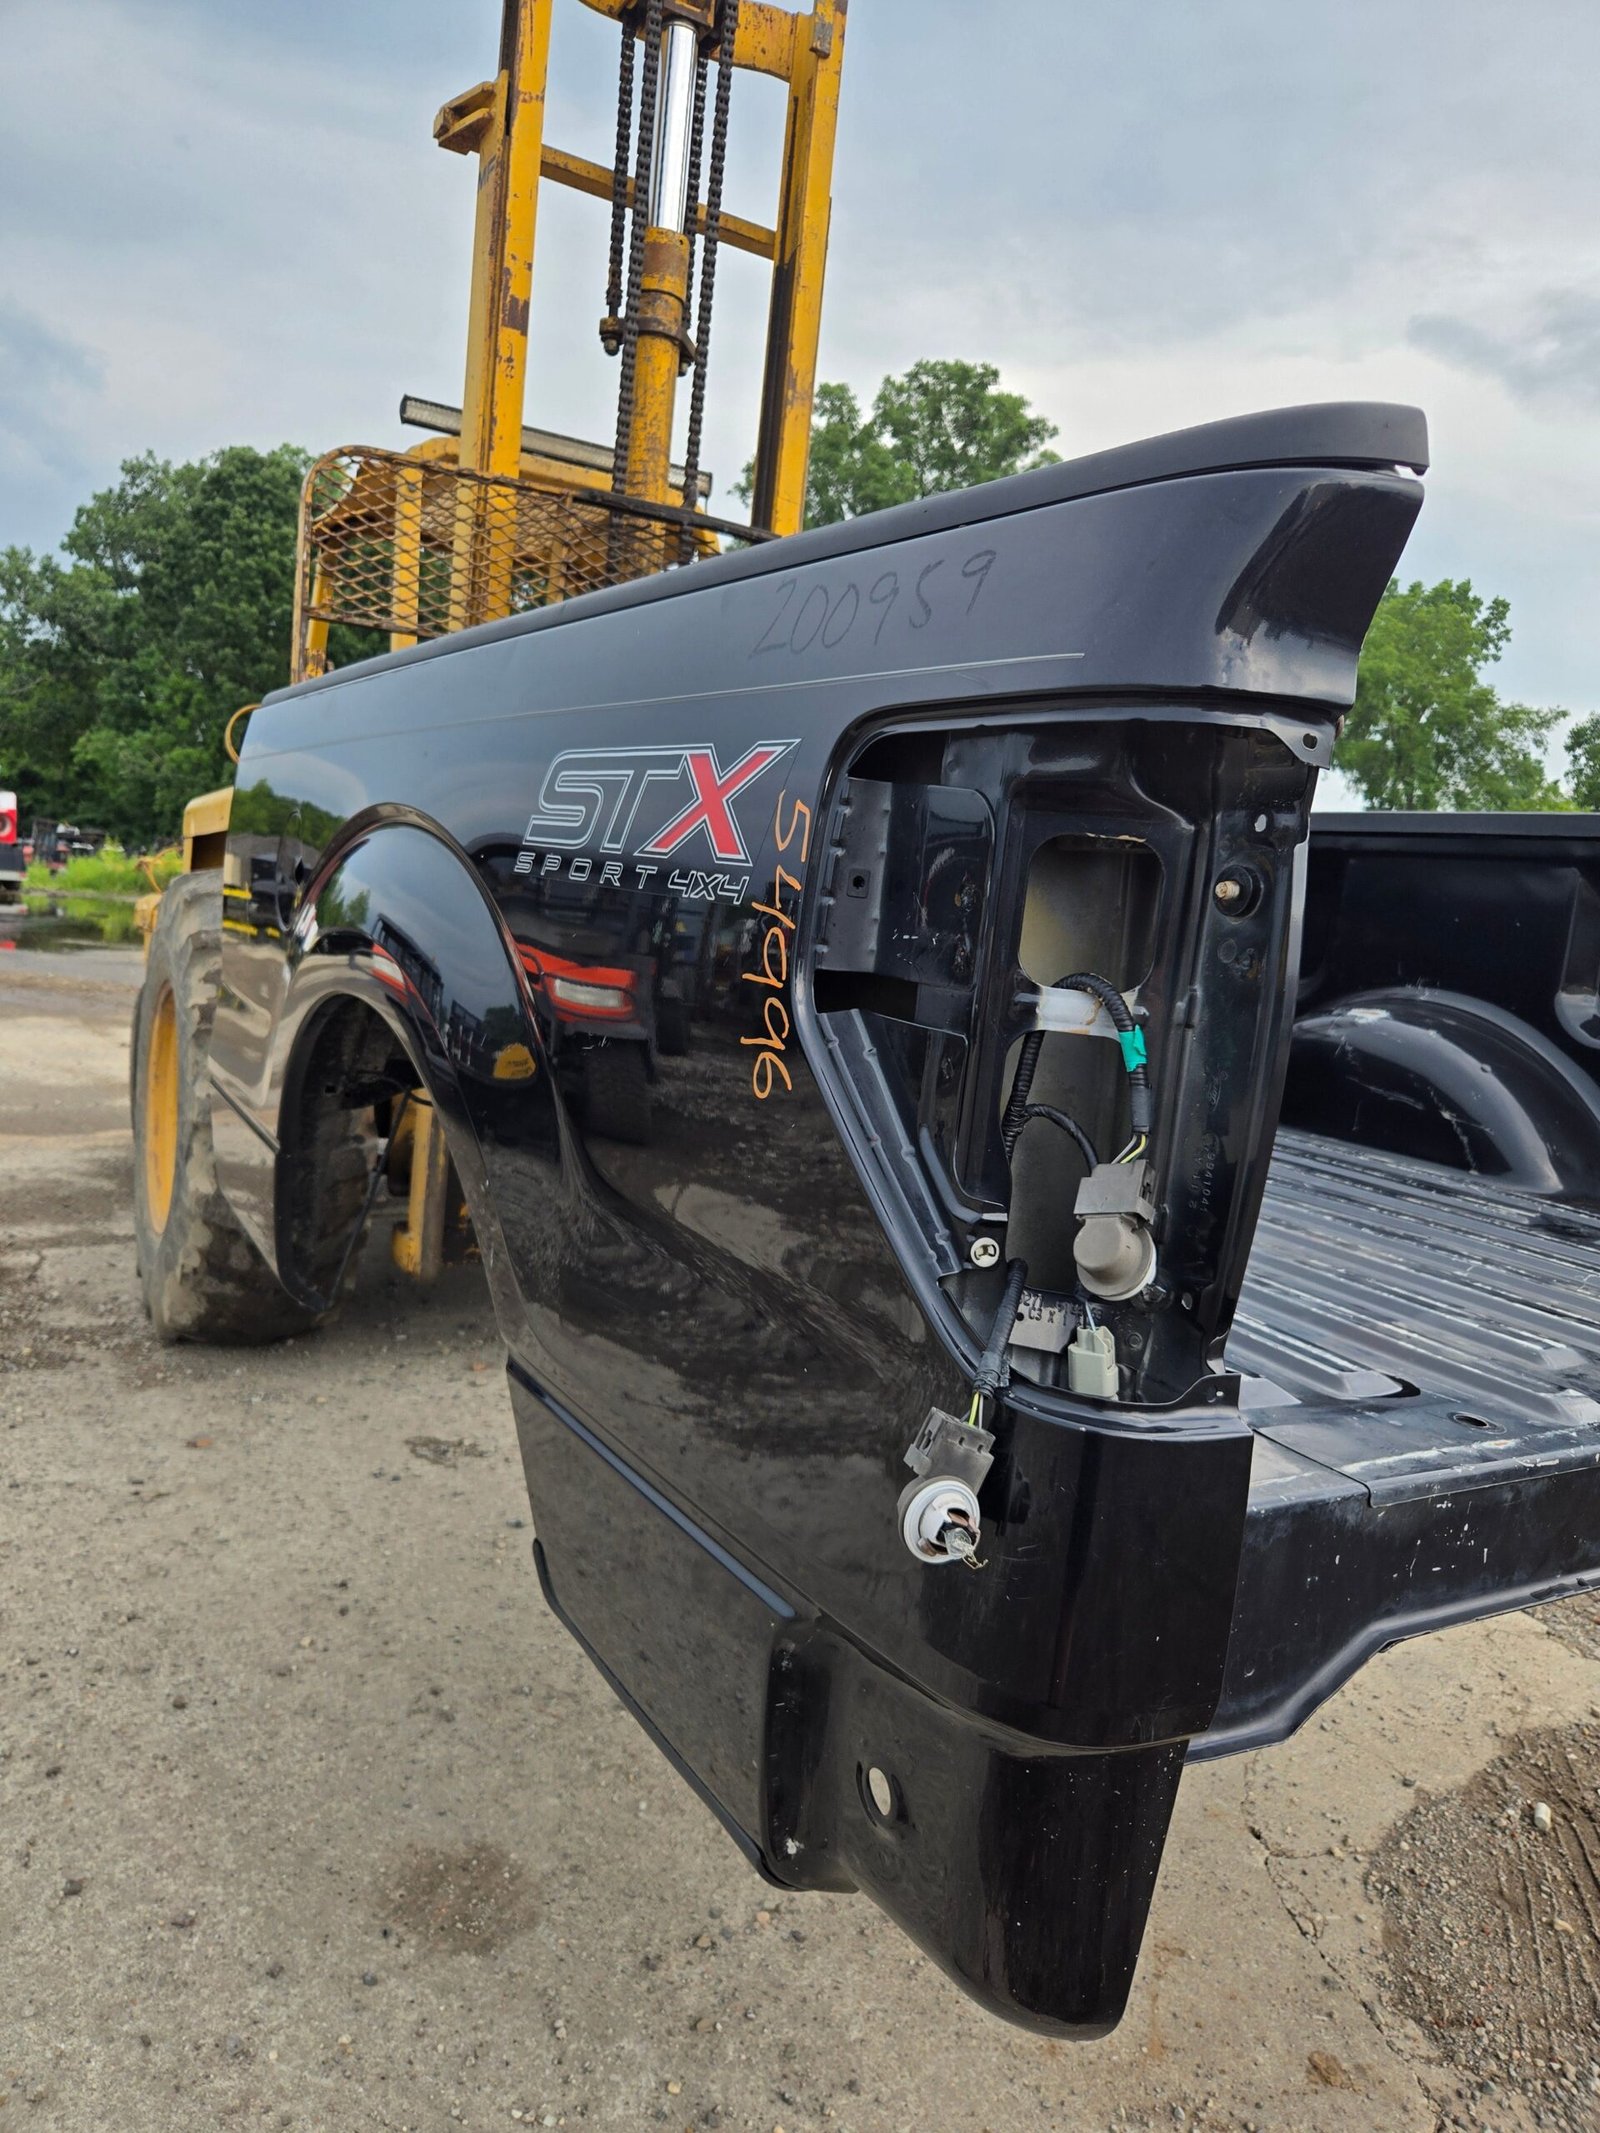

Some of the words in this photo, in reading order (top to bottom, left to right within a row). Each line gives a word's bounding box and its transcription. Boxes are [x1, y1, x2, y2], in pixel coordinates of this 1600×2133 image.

[750, 549, 997, 657] 200959
[522, 737, 802, 867] STX
[513, 851, 658, 890] SPORT
[667, 868, 750, 905] 4X4
[741, 788, 811, 1099] 54996
